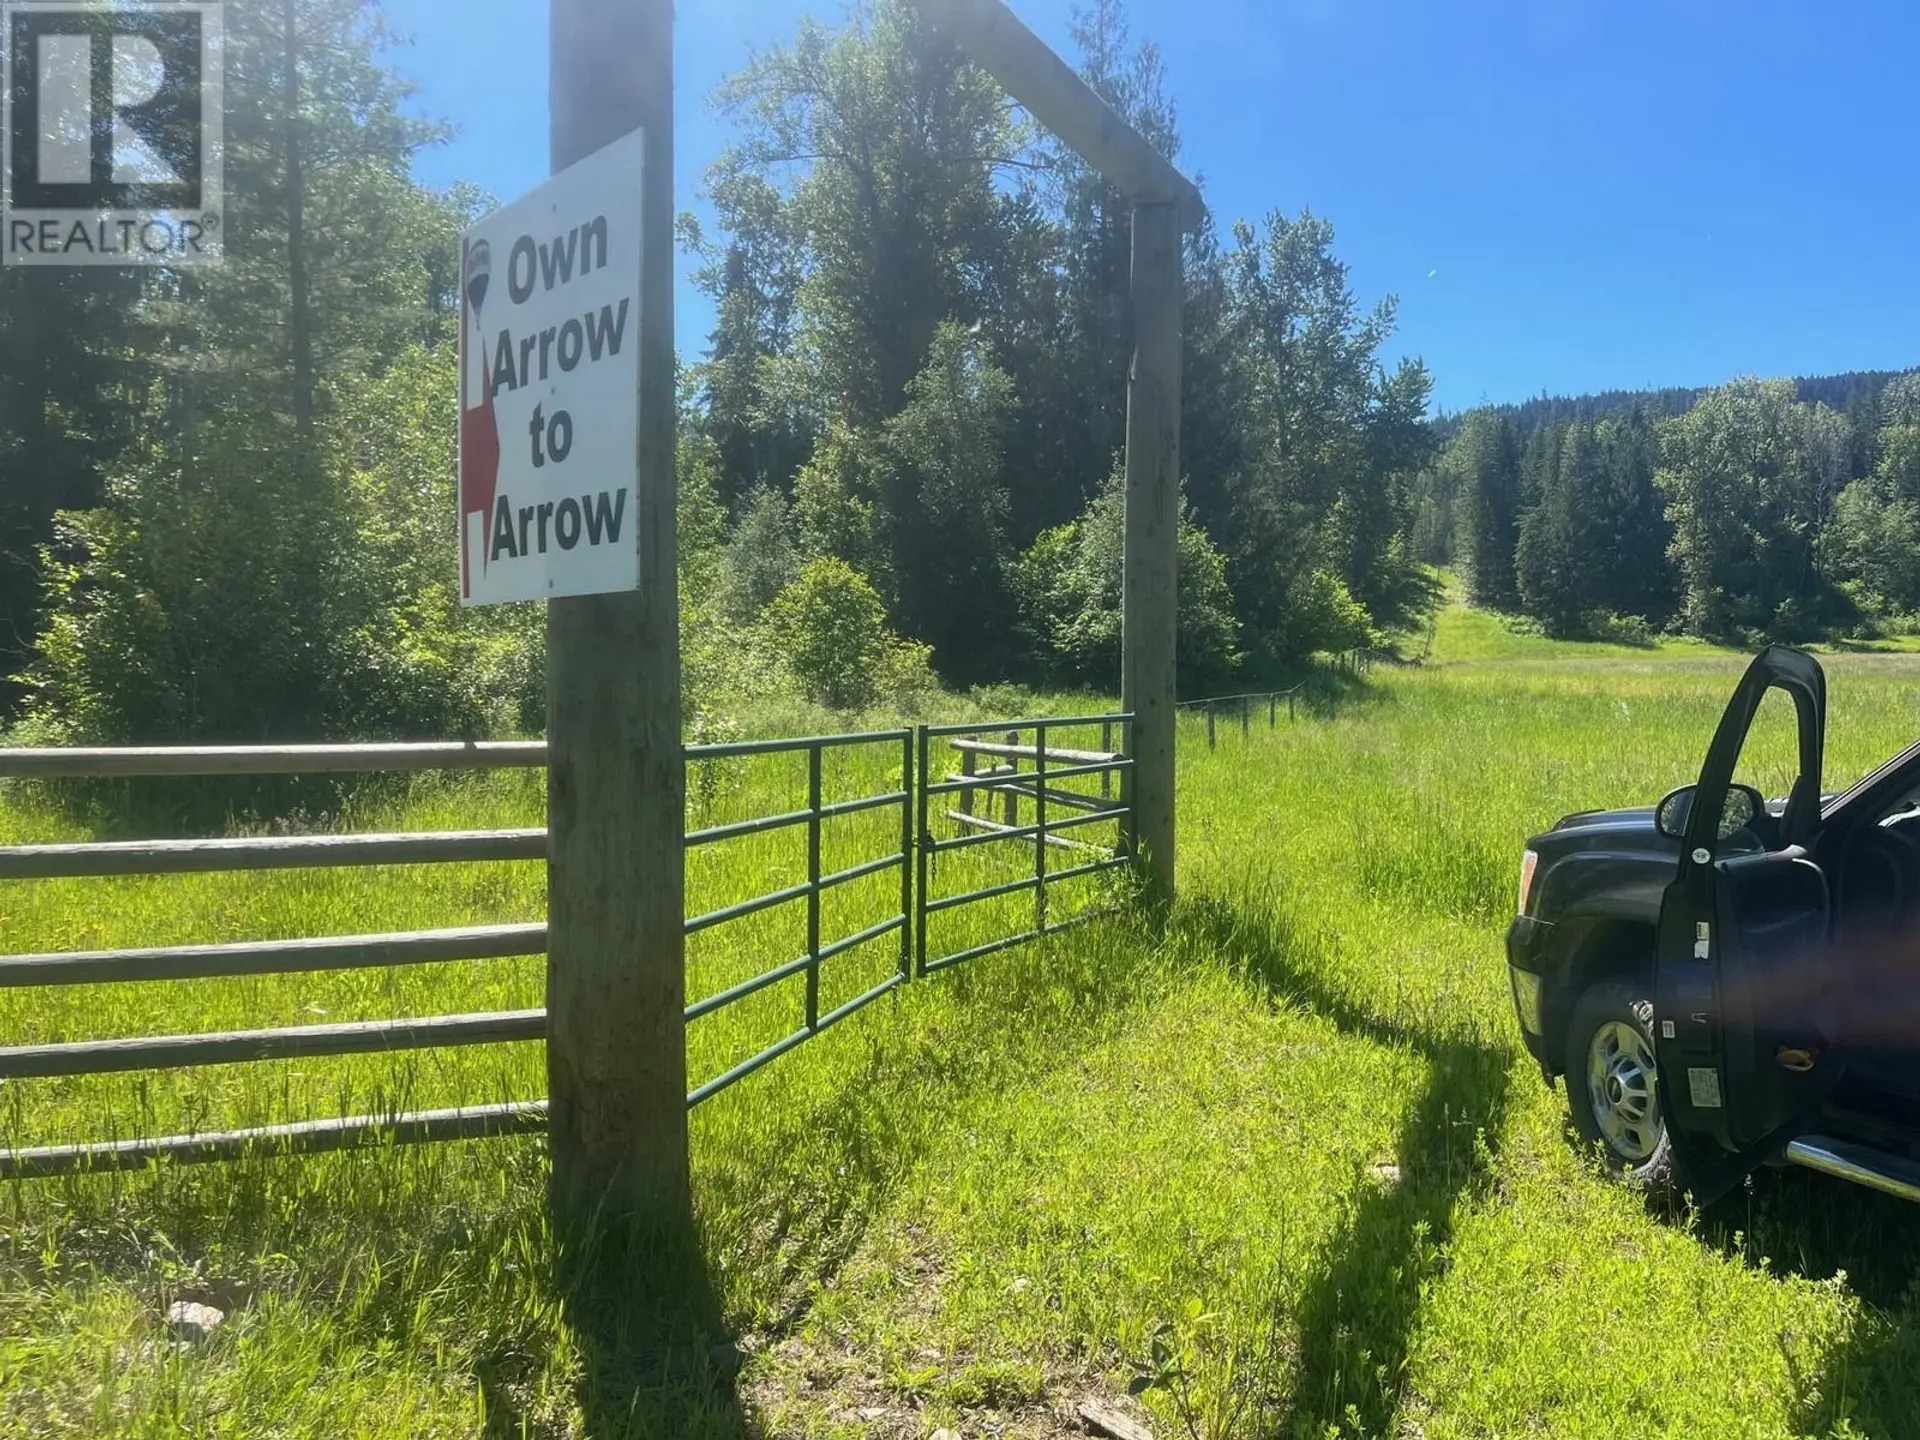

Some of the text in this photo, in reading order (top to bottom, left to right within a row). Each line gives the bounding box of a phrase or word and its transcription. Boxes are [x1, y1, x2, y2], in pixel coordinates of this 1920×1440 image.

[508, 214, 607, 305] Own
[492, 297, 629, 397] Arrow
[529, 402, 573, 468] to
[491, 487, 627, 562] Arrow
